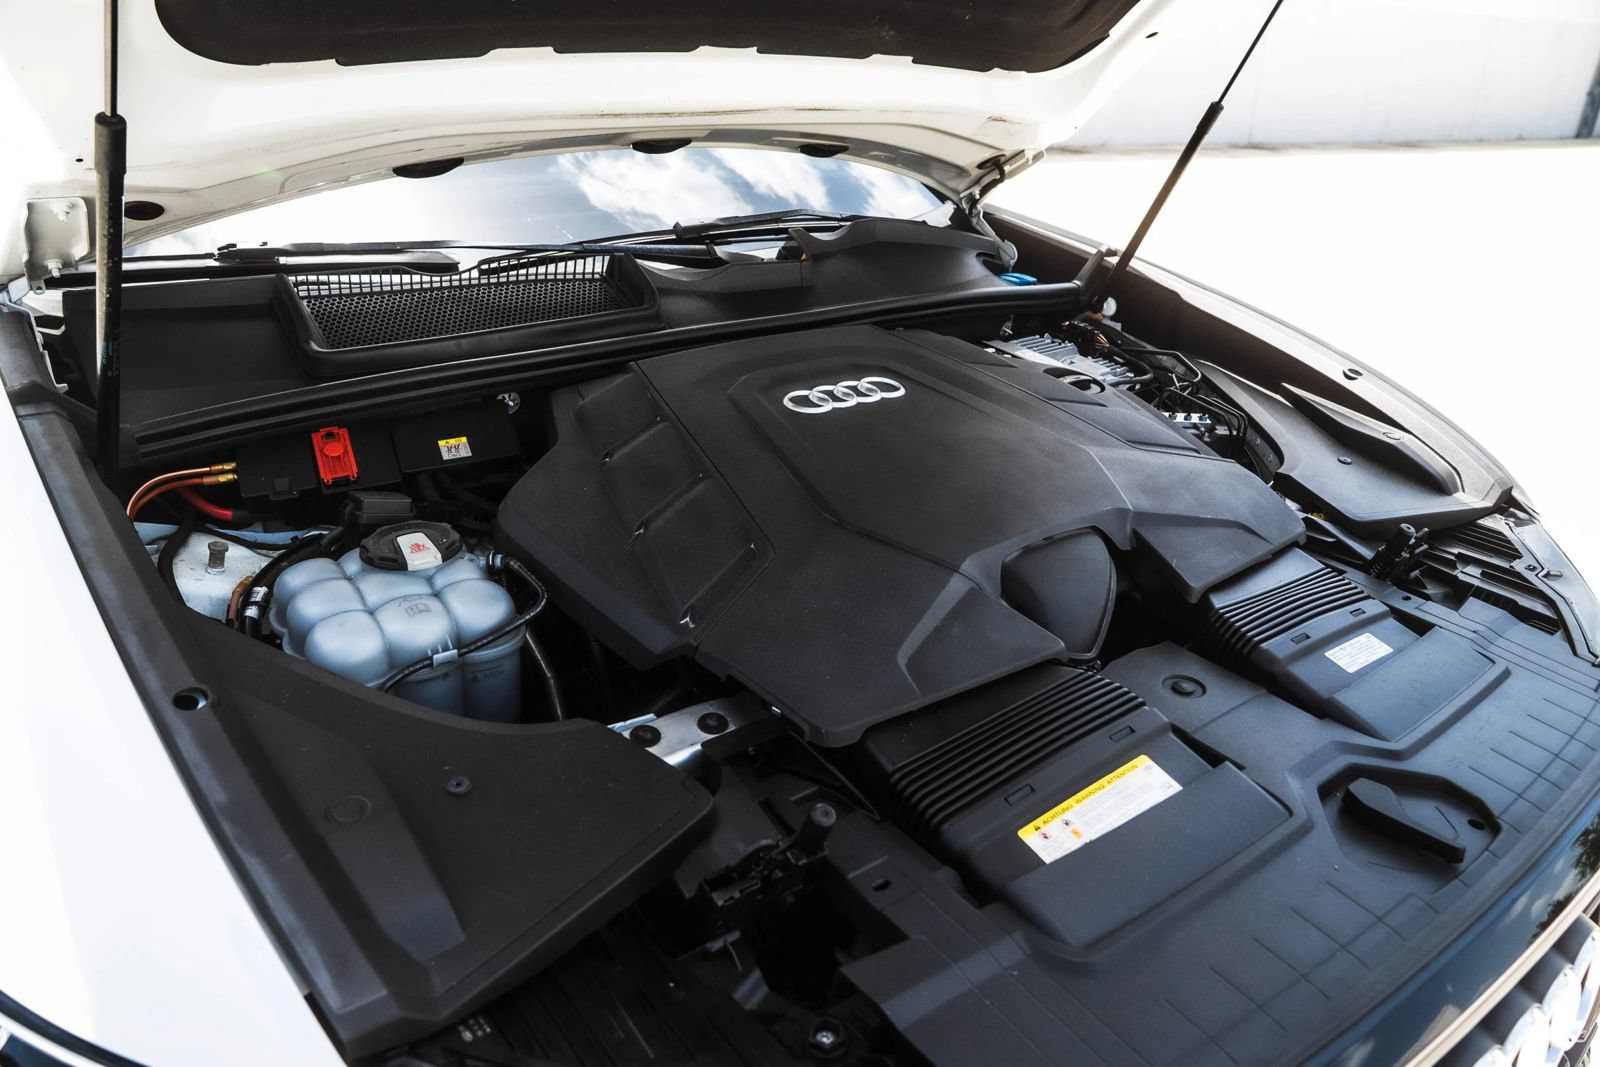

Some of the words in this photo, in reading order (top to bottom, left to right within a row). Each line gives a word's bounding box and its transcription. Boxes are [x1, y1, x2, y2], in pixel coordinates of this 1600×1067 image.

[1042, 804, 1073, 825] ACHTUNG
[1075, 783, 1105, 804] WARNING
[1106, 764, 1138, 785] ATTENTION
